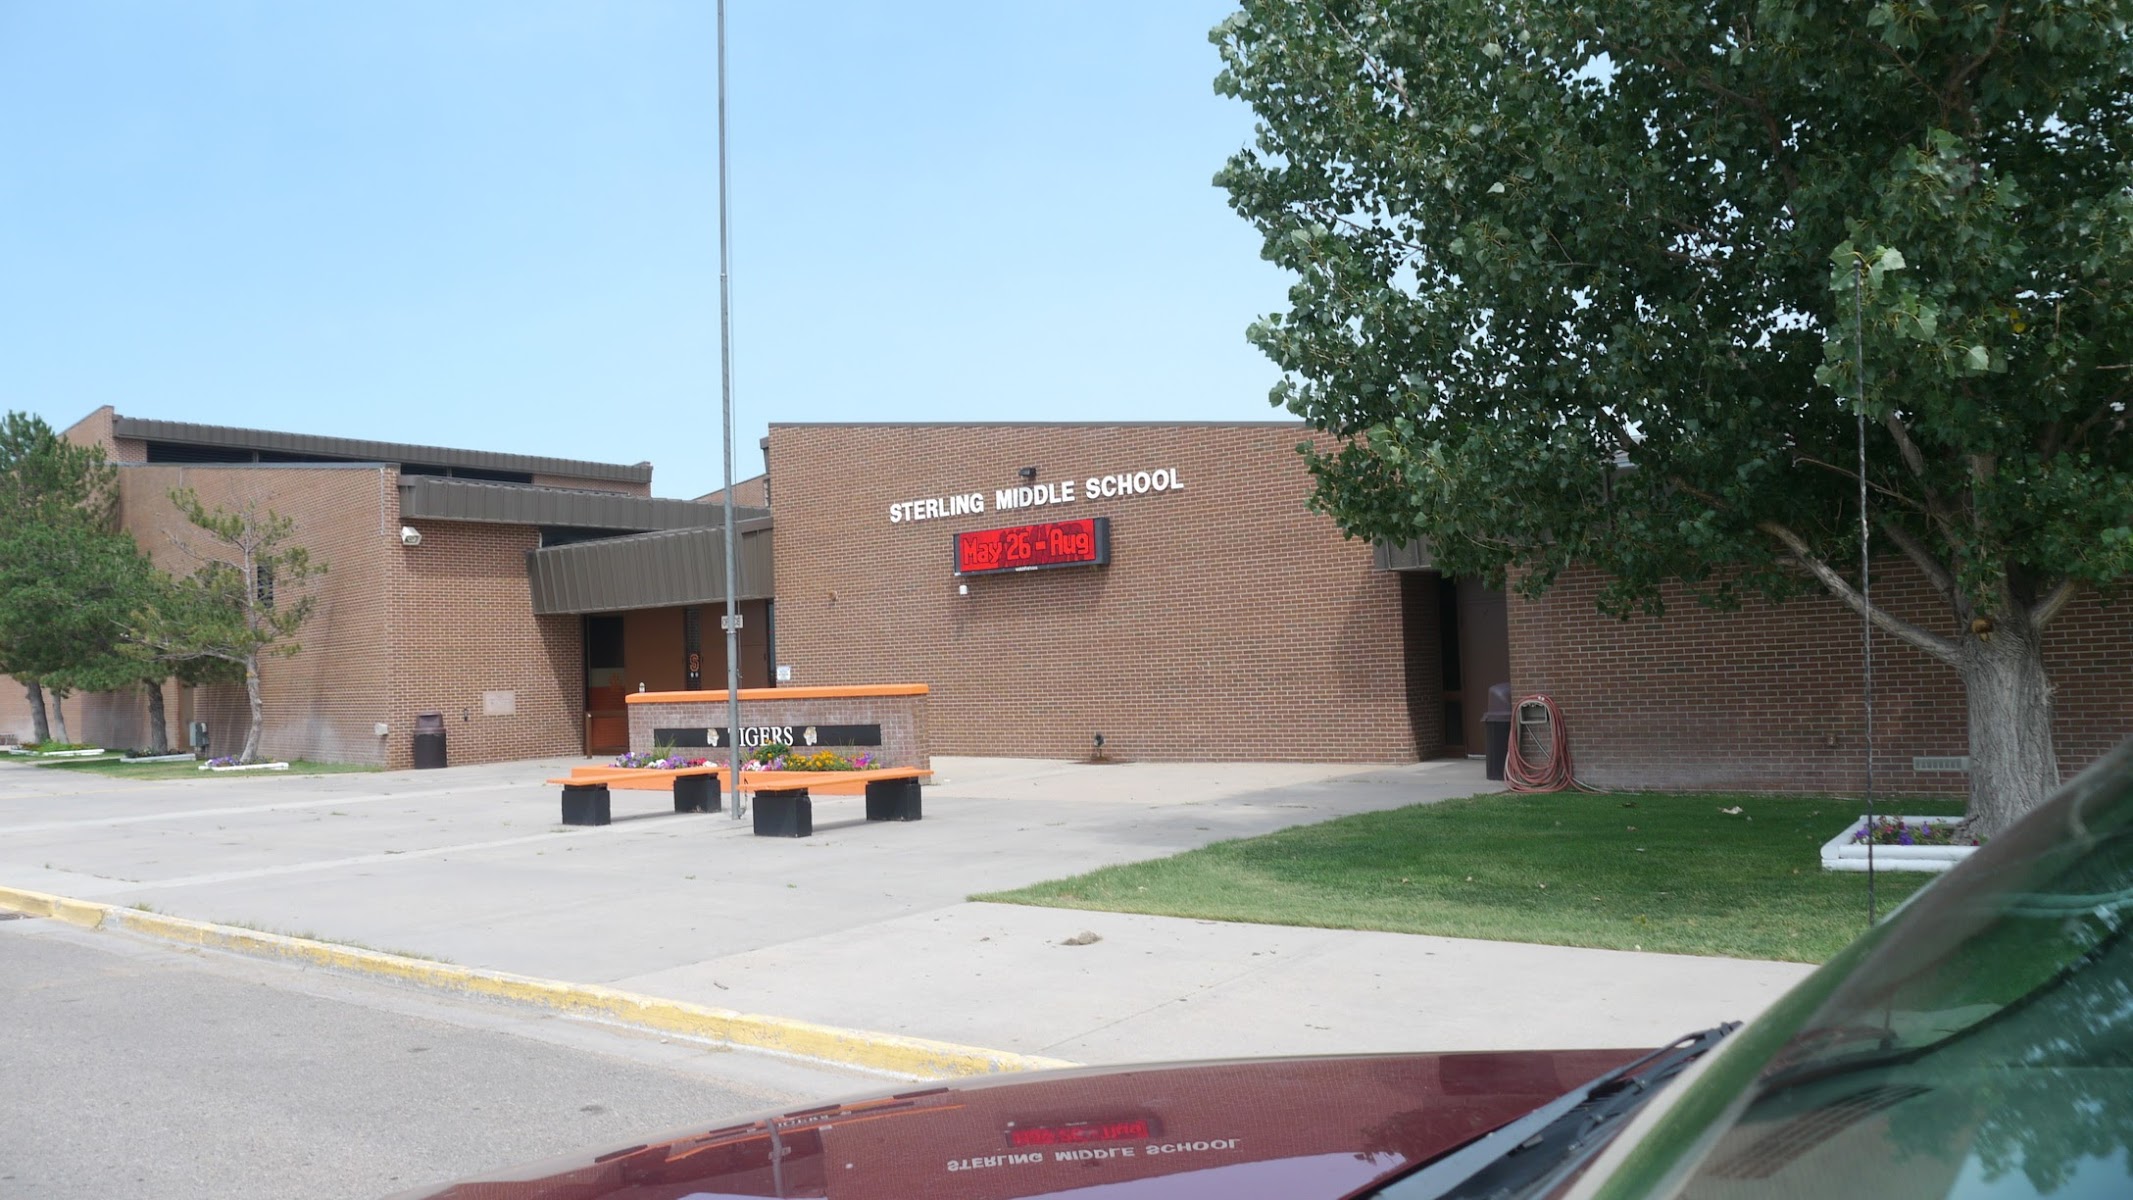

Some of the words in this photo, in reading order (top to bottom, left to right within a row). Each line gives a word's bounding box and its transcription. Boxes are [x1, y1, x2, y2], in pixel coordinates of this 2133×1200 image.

[890, 493, 984, 523] STERLING
[996, 481, 1075, 510] MIDDLE
[1086, 468, 1184, 499] SCHOOL
[963, 537, 1002, 565] May
[1006, 532, 1031, 560] 26
[1050, 528, 1089, 556] Aug
[728, 726, 793, 746] IGERS
